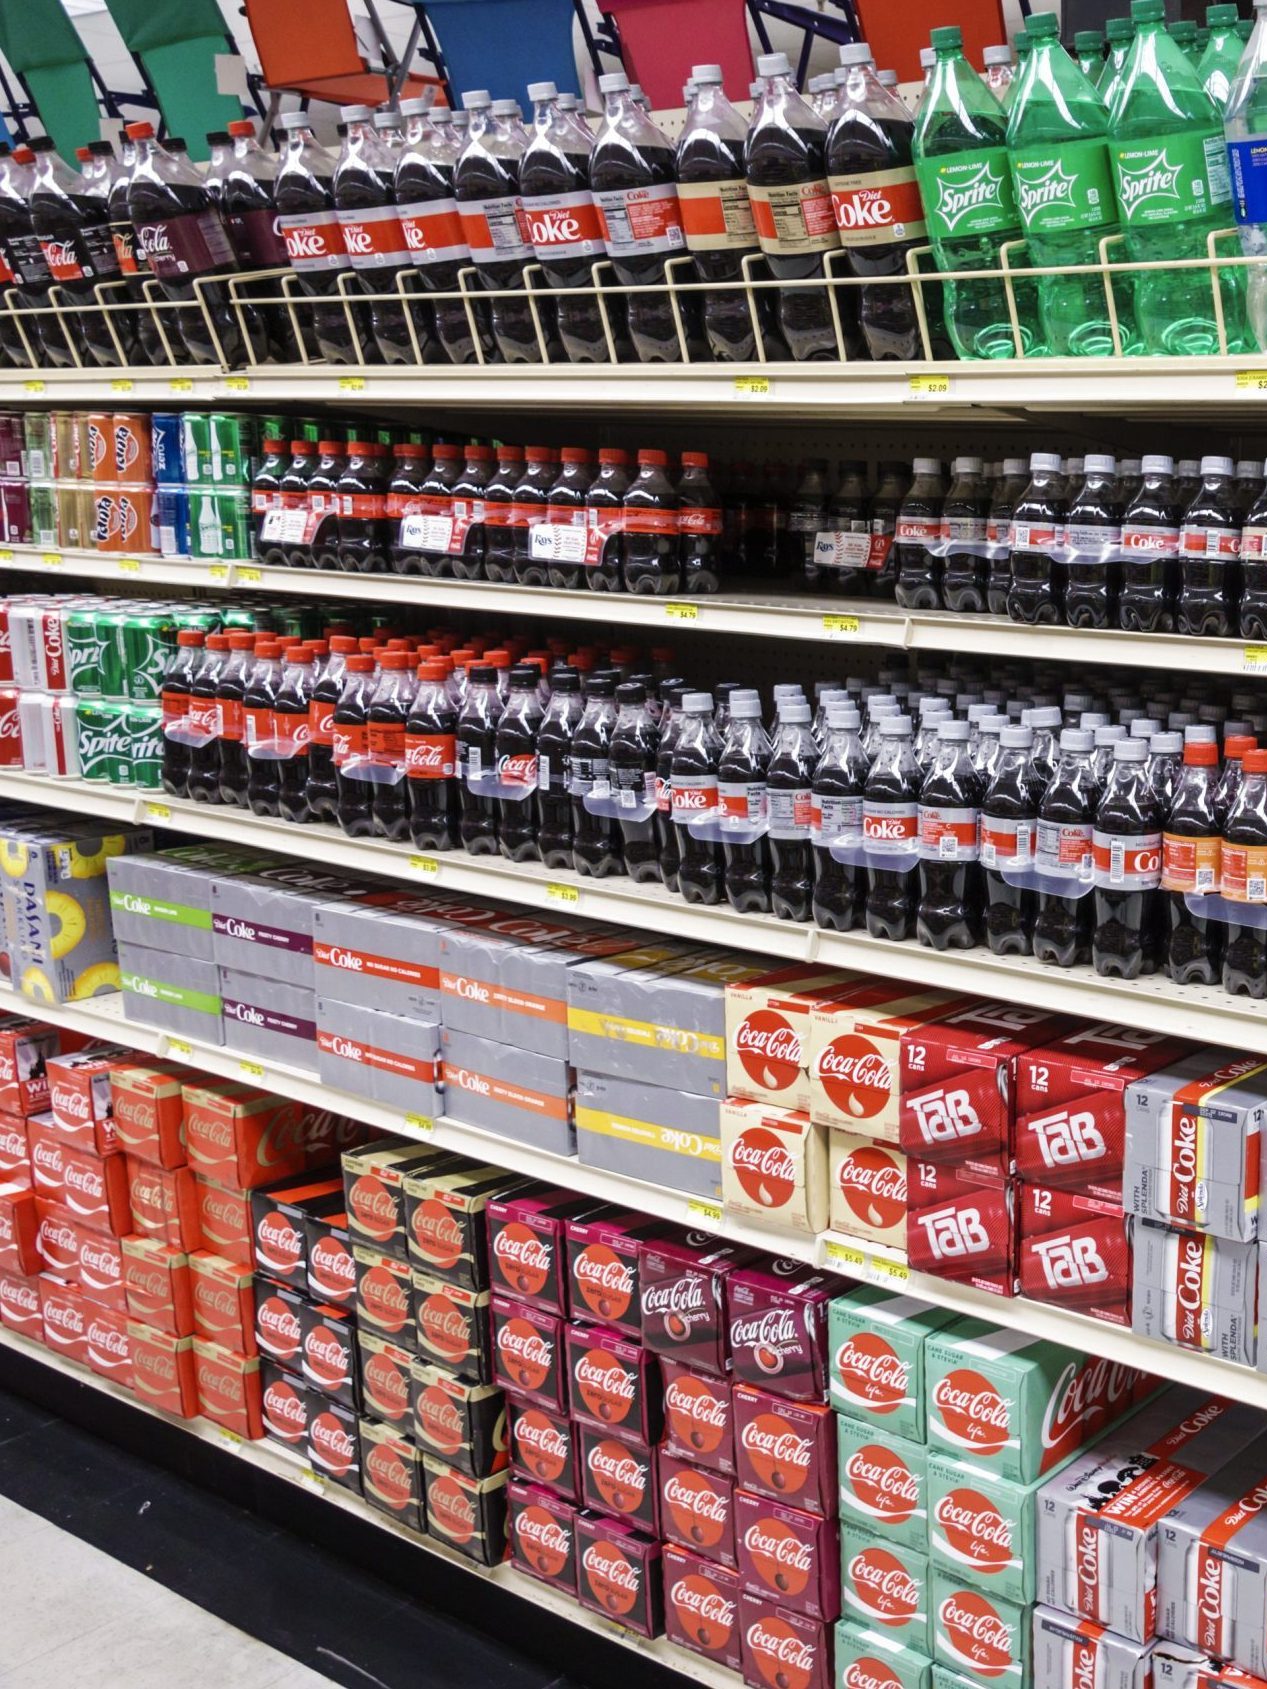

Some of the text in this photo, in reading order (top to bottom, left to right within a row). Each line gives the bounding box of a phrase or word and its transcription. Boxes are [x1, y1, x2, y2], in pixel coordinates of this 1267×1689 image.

[1125, 150, 1159, 160] LEMON-LIME
[946, 162, 983, 174] LEMON-LIME
[1122, 168, 1174, 198] Sprite
[859, 189, 882, 202] Diet
[942, 182, 998, 212] Sprite
[928, 384, 947, 393] $2.09
[900, 524, 927, 537] Coke
[1130, 533, 1165, 551] Coke
[840, 623, 858, 632] $4.79
[863, 818, 905, 839] Coke
[23, 882, 44, 965] DASANI
[226, 918, 255, 940] Coke
[330, 947, 362, 971] Coke
[457, 979, 490, 1002] Coke
[814, 1015, 838, 1023] VANILLA
[734, 1020, 803, 1063] Coca-Cola
[908, 1045, 926, 1062] 12
[816, 1045, 893, 1091] Coca-Cola
[1029, 1066, 1048, 1084] 12
[1031, 1083, 1048, 1092] cans
[51, 1085, 90, 1119] Coca-Cola
[1136, 1094, 1148, 1107] 12
[1172, 1116, 1197, 1217] Diet Coke
[64, 1165, 104, 1199] Coca-Cola
[1140, 1167, 1149, 1215] SPLENDA
[703, 1209, 721, 1221] $4.99
[258, 1219, 303, 1255] Coca-Cola
[569, 1225, 588, 1235] CHERRY
[493, 1231, 551, 1270] Coca-Cola
[888, 1267, 907, 1279] $5.49
[641, 1275, 704, 1314] Coca-Cola
[419, 1299, 473, 1341] Coca-Cola
[835, 1341, 911, 1392] Coca-Cola
[932, 1377, 1014, 1428] Coca-Cola
[1107, 1492, 1138, 1515] WIN
[1165, 1530, 1177, 1542] 12
[583, 1547, 639, 1590] Coca-Cola
[1077, 1528, 1097, 1612] Diet Coke
[1198, 1557, 1222, 1648] Diet Coke
[746, 1617, 813, 1668] Coca-Cola
